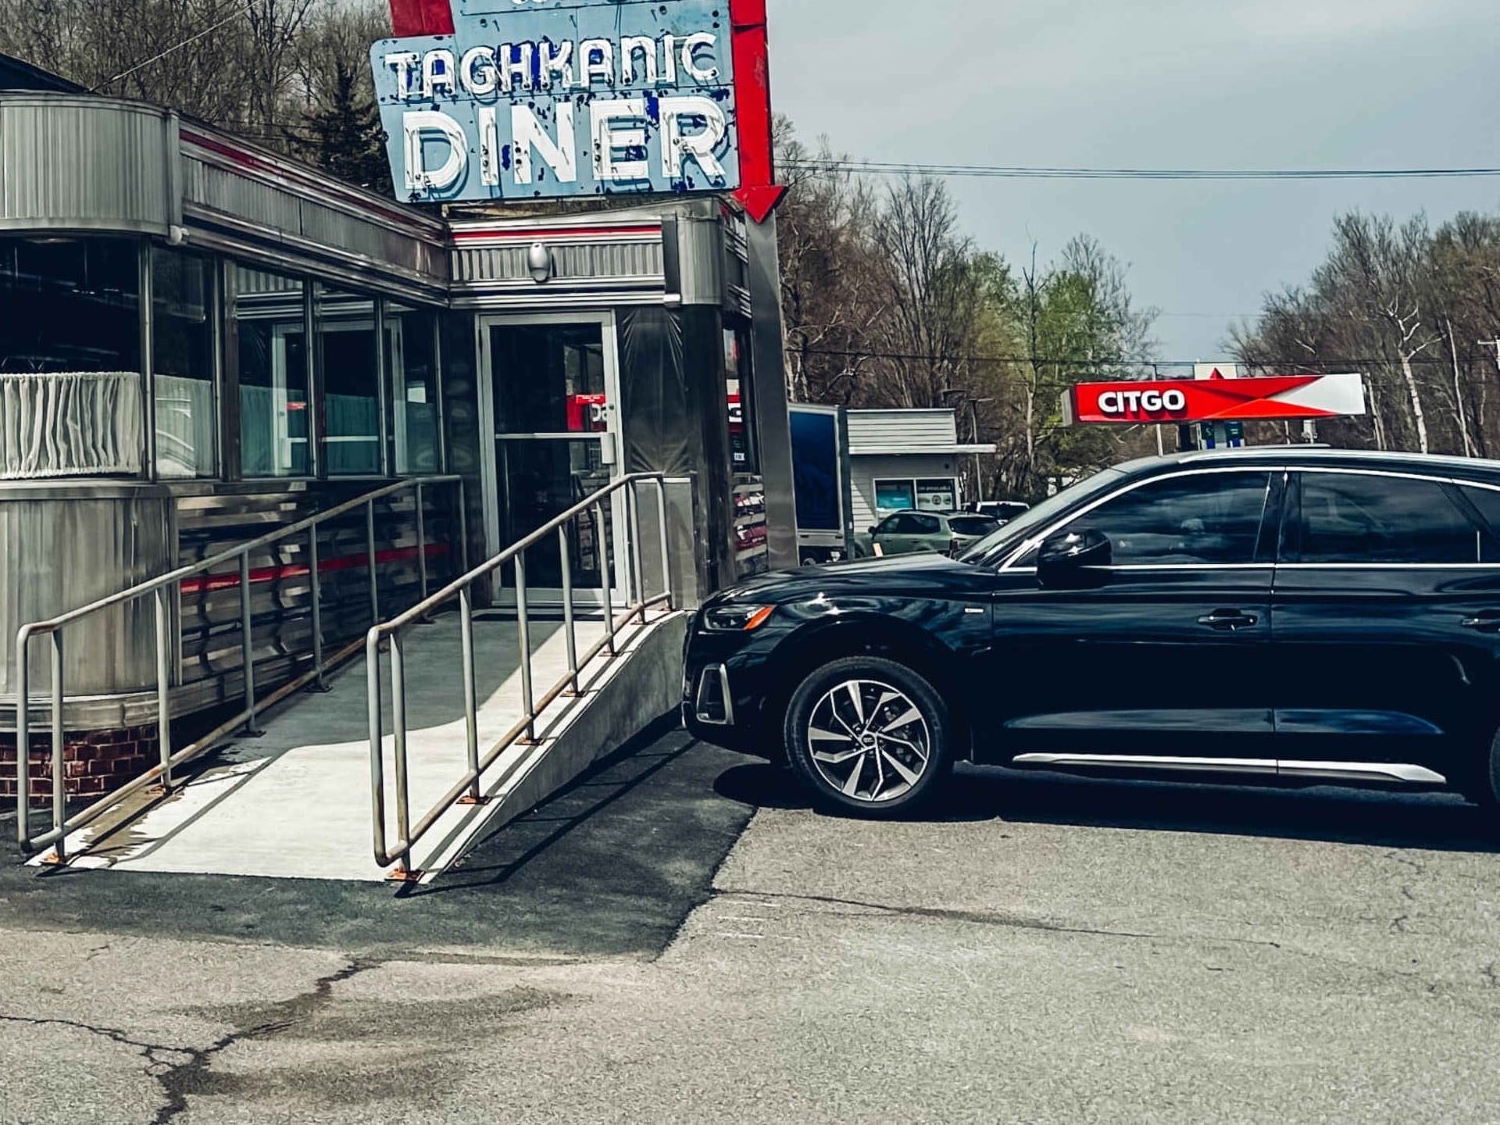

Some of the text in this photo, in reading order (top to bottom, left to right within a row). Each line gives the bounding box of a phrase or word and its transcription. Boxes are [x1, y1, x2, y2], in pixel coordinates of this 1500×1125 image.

[385, 31, 719, 99] TAGHKANIC
[402, 96, 727, 189] DINER
[1097, 389, 1186, 414] CITGO
